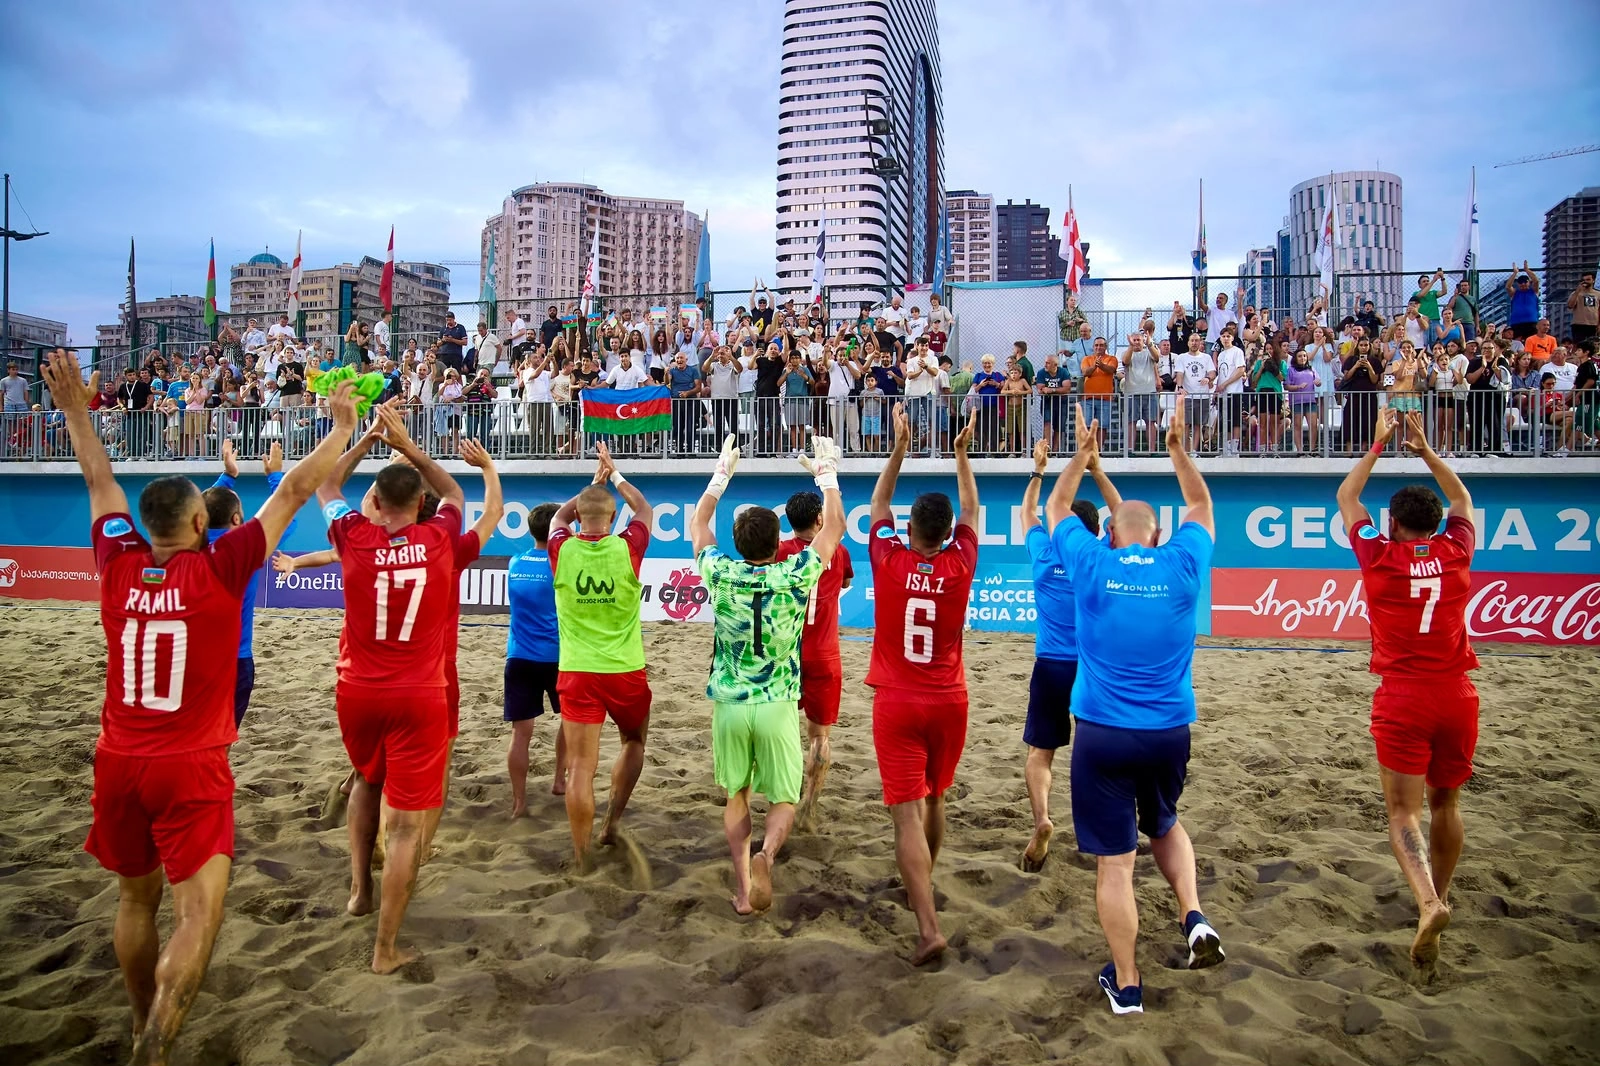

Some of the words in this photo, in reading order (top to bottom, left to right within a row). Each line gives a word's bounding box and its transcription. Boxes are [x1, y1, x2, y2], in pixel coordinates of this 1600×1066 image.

[464, 501, 531, 540] RO
[1554, 508, 1600, 552] 2
[374, 544, 427, 566] SABIR
[275, 571, 344, 590] #OneHu
[459, 568, 510, 606] UM
[658, 585, 711, 605] GEO
[905, 572, 945, 594] ISA.Z
[979, 589, 1035, 603] SOCCE
[1124, 584, 1149, 592] BONA
[1150, 584, 1169, 592] DEA
[124, 587, 186, 614] RAMIL
[373, 567, 427, 642] 17
[968, 606, 1011, 621] RGIA
[1015, 607, 1038, 622] 20
[1410, 576, 1442, 634] 7
[1464, 580, 1600, 640] Coca-Co
[752, 591, 763, 658] 1
[903, 597, 936, 664] 6
[120, 617, 188, 712] 10
